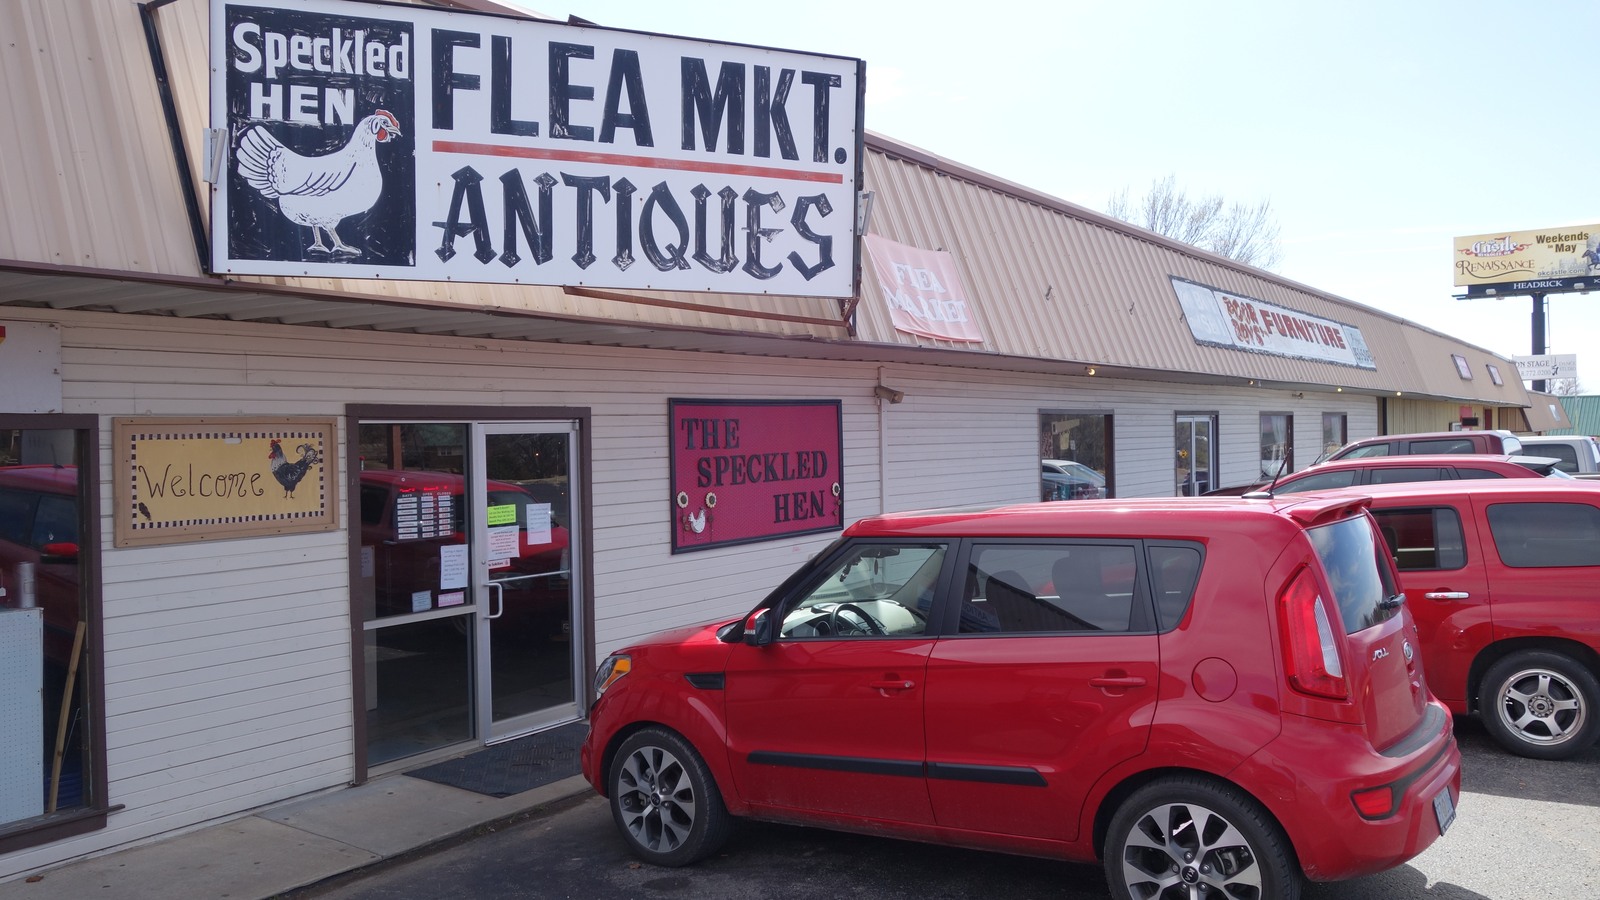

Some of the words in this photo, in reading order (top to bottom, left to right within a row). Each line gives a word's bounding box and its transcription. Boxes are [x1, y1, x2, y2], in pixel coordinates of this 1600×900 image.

[233, 22, 410, 79] Speckled
[250, 82, 355, 125] HEN
[431, 27, 654, 147] FLEA
[681, 56, 848, 165] MKT.
[431, 165, 836, 282] ANTIQUES
[1536, 232, 1589, 244] Weekends
[1472, 236, 1518, 254] Castle
[1555, 243, 1577, 253] May
[892, 261, 946, 293] FLEA
[1456, 260, 1535, 277] RENAISSANCE
[1513, 280, 1563, 289] HEADRICK
[1259, 308, 1346, 349] FURNITURE
[1527, 360, 1550, 368] STAGE
[681, 418, 740, 450] THE
[138, 463, 264, 498] Welcome
[697, 450, 828, 488] SPECKLED
[773, 490, 825, 523] HEN
